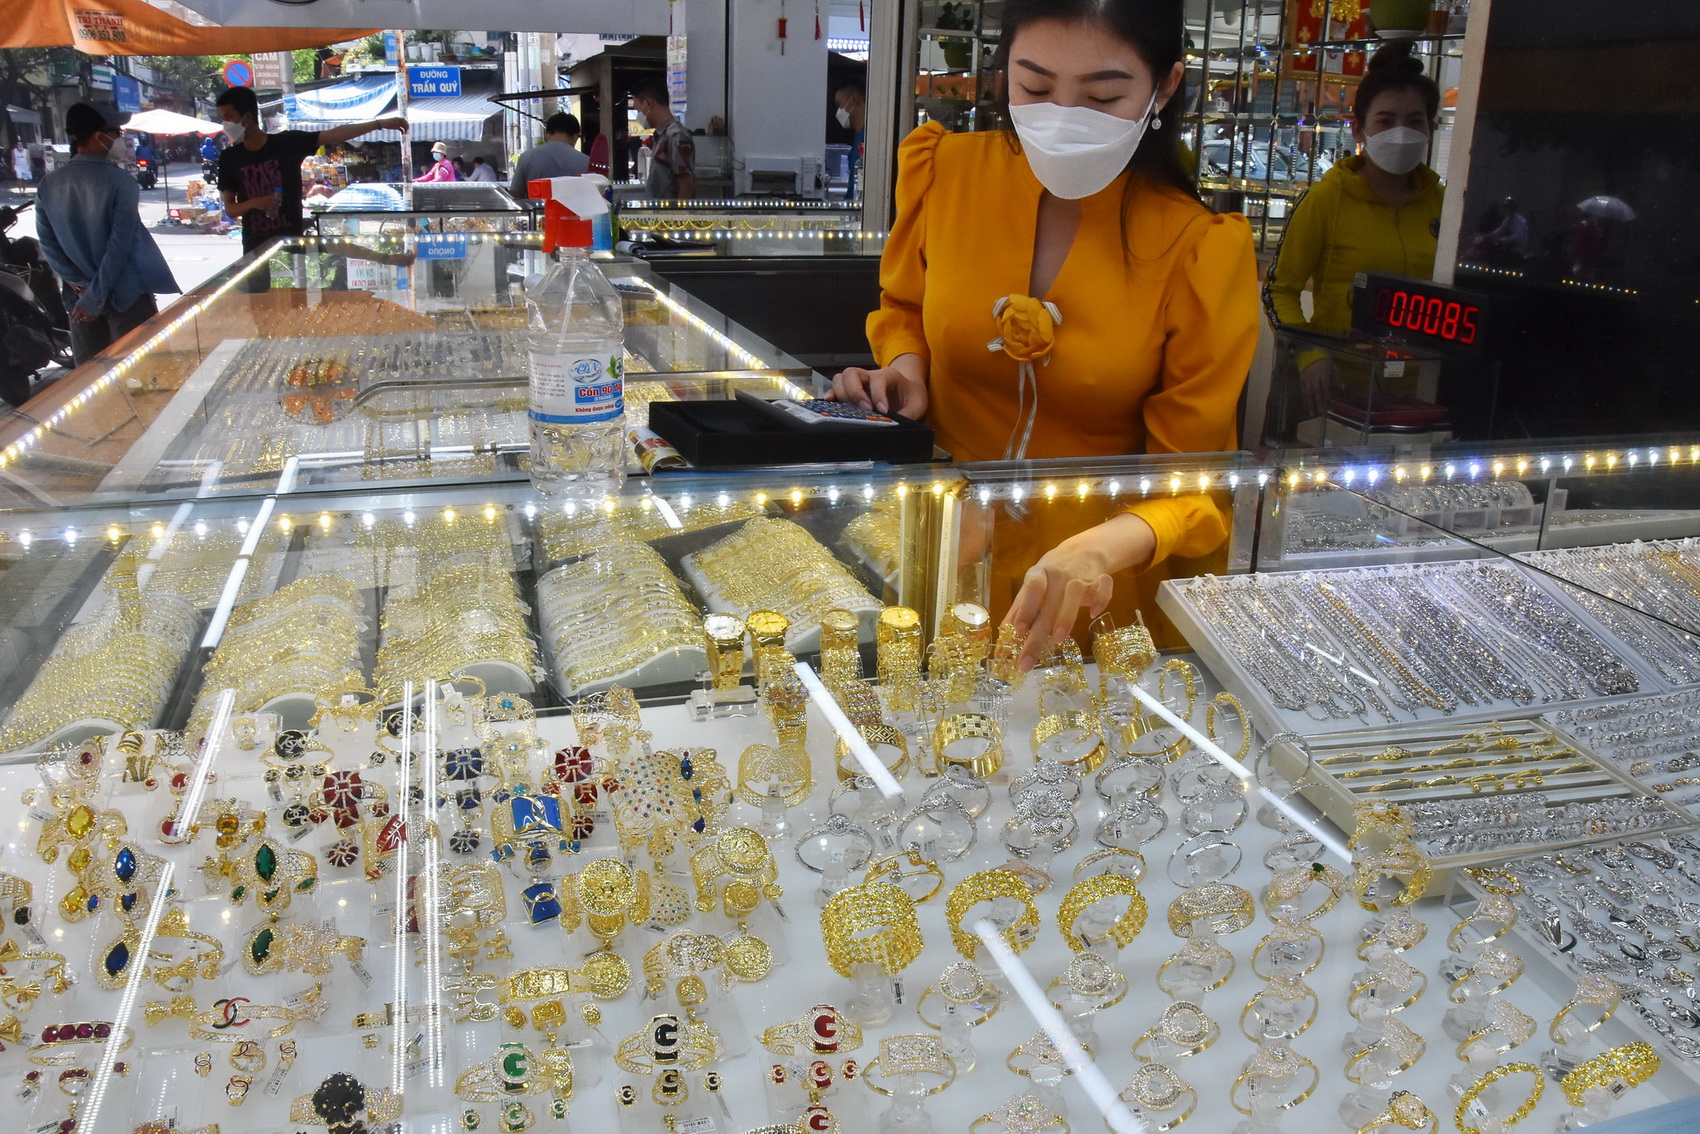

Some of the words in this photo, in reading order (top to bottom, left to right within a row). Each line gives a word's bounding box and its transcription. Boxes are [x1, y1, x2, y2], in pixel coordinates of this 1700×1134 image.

[420, 69, 449, 79] ĐƯỜNG
[411, 79, 436, 93] TRẦN
[440, 80, 458, 93] QUÝ
[602, 386, 612, 394] 90
